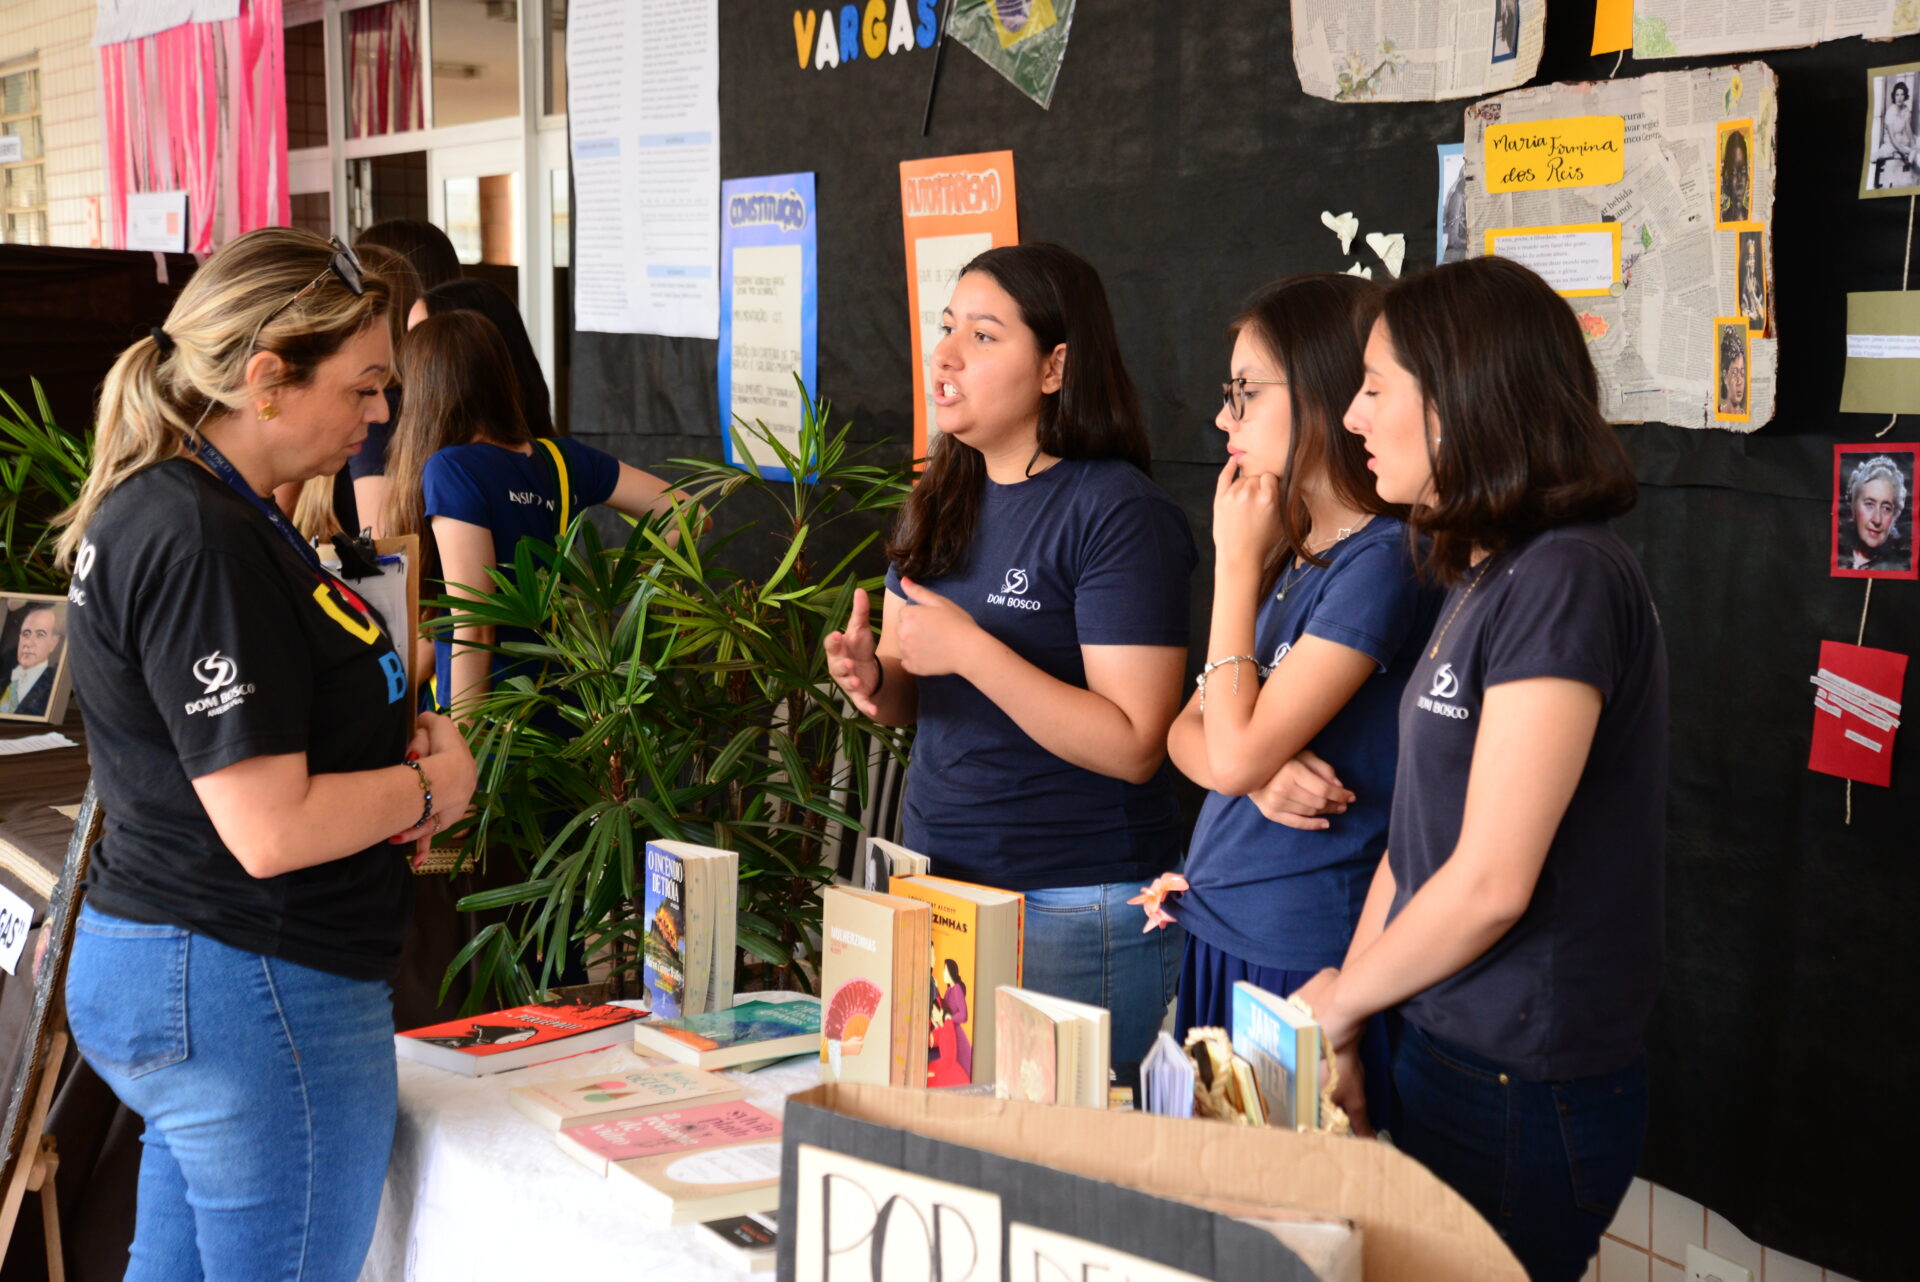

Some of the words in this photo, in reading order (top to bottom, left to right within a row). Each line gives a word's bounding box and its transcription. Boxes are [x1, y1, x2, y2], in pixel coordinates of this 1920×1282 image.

[793, 0, 937, 70] VARGAS
[1501, 167, 1536, 184] dos
[1546, 157, 1584, 183] Reis
[987, 593, 1006, 606] DOM
[1007, 597, 1041, 611] BOSCO
[185, 695, 219, 716] DOM
[220, 682, 256, 704] BOSCO
[1432, 700, 1469, 720] BOSCO
[647, 850, 655, 871] O
[652, 872, 662, 895] DE
[931, 912, 968, 934] ZINHAS
